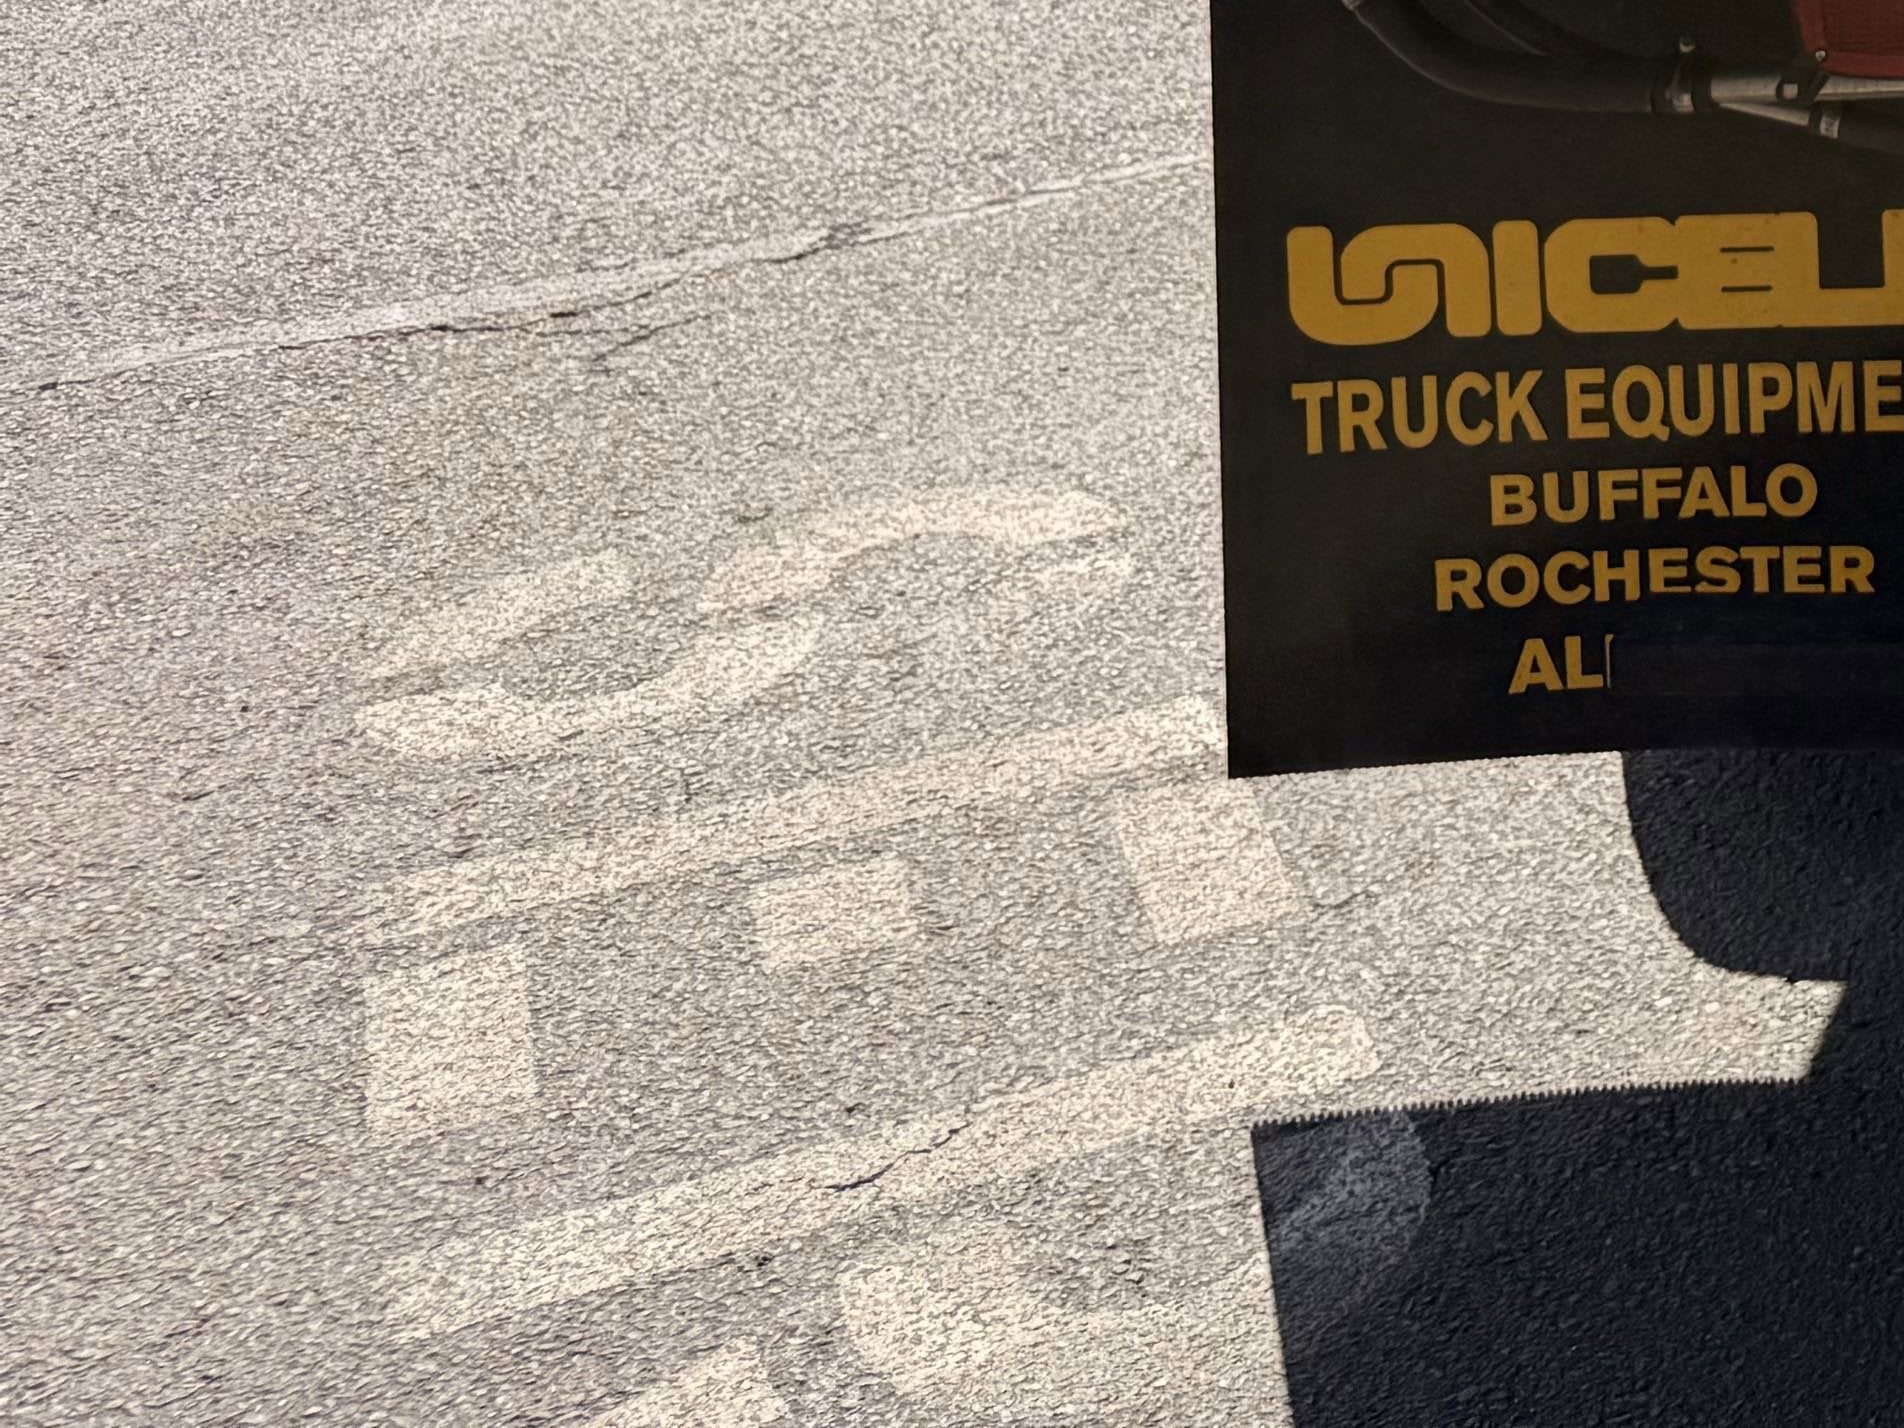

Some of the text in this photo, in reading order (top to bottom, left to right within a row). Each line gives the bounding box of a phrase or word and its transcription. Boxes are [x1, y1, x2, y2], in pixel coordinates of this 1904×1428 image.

[1291, 369, 1548, 455] TRUCK
[1490, 462, 1818, 527] BUFFALO
[1434, 545, 1876, 612] ROCHESTER
[1508, 633, 1614, 695] AL
